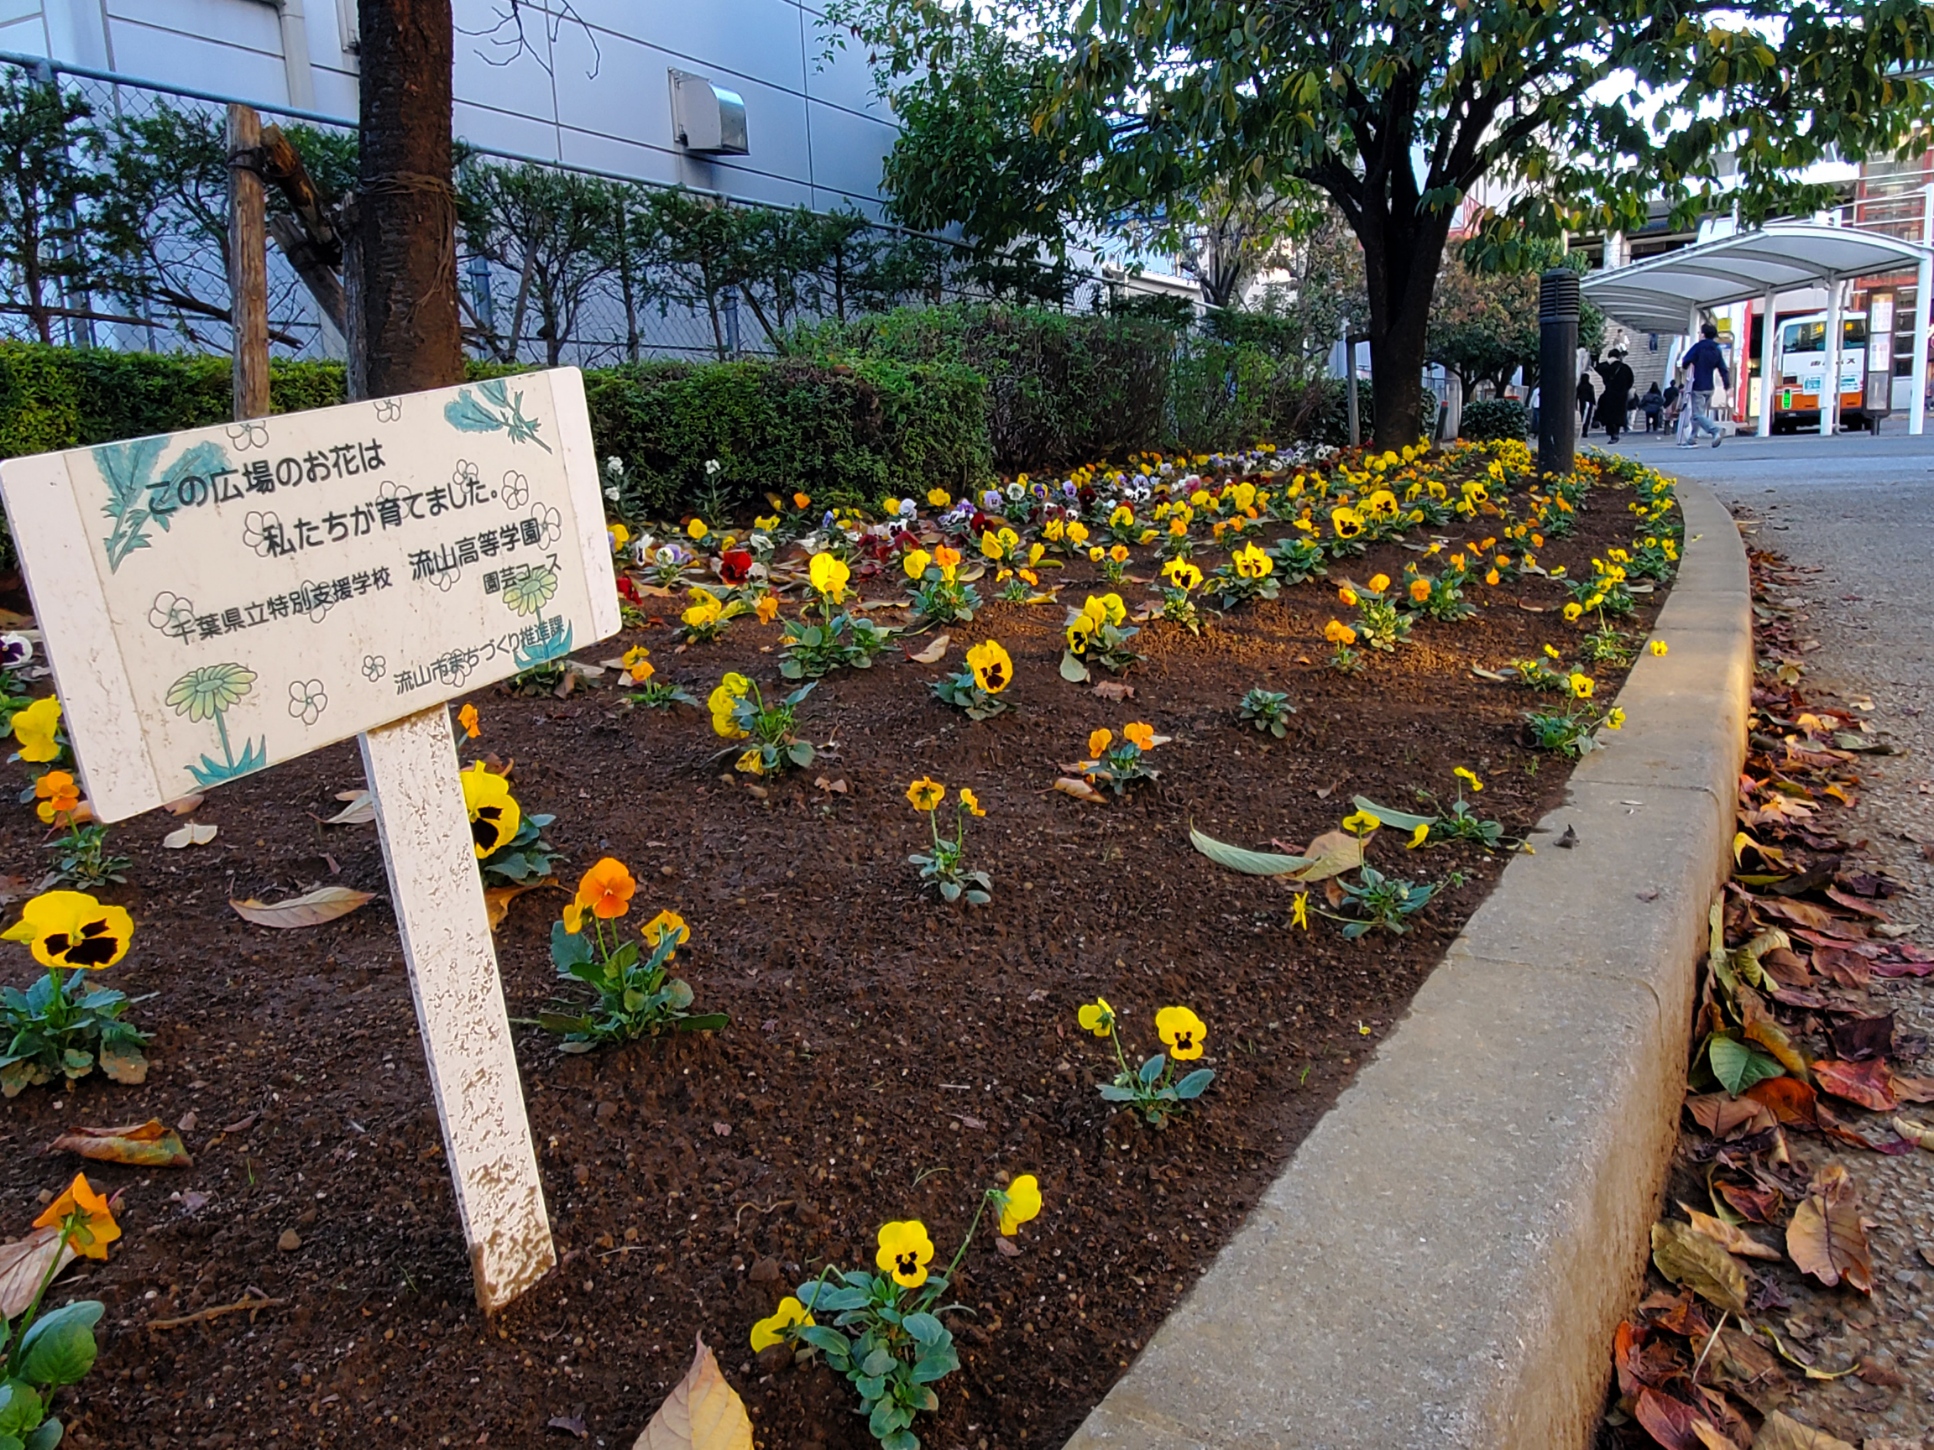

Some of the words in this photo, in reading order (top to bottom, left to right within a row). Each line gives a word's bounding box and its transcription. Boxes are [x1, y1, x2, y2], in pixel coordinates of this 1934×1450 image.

[146, 438, 386, 515] この広場のお花は
[263, 477, 498, 558] 私たちが育てました。
[172, 566, 392, 645] 千葉県立特別支援学校
[408, 517, 541, 581] 流山高等学園
[483, 553, 562, 595] 園芸コース
[393, 614, 566, 695] 流山市まちづくり推進課
